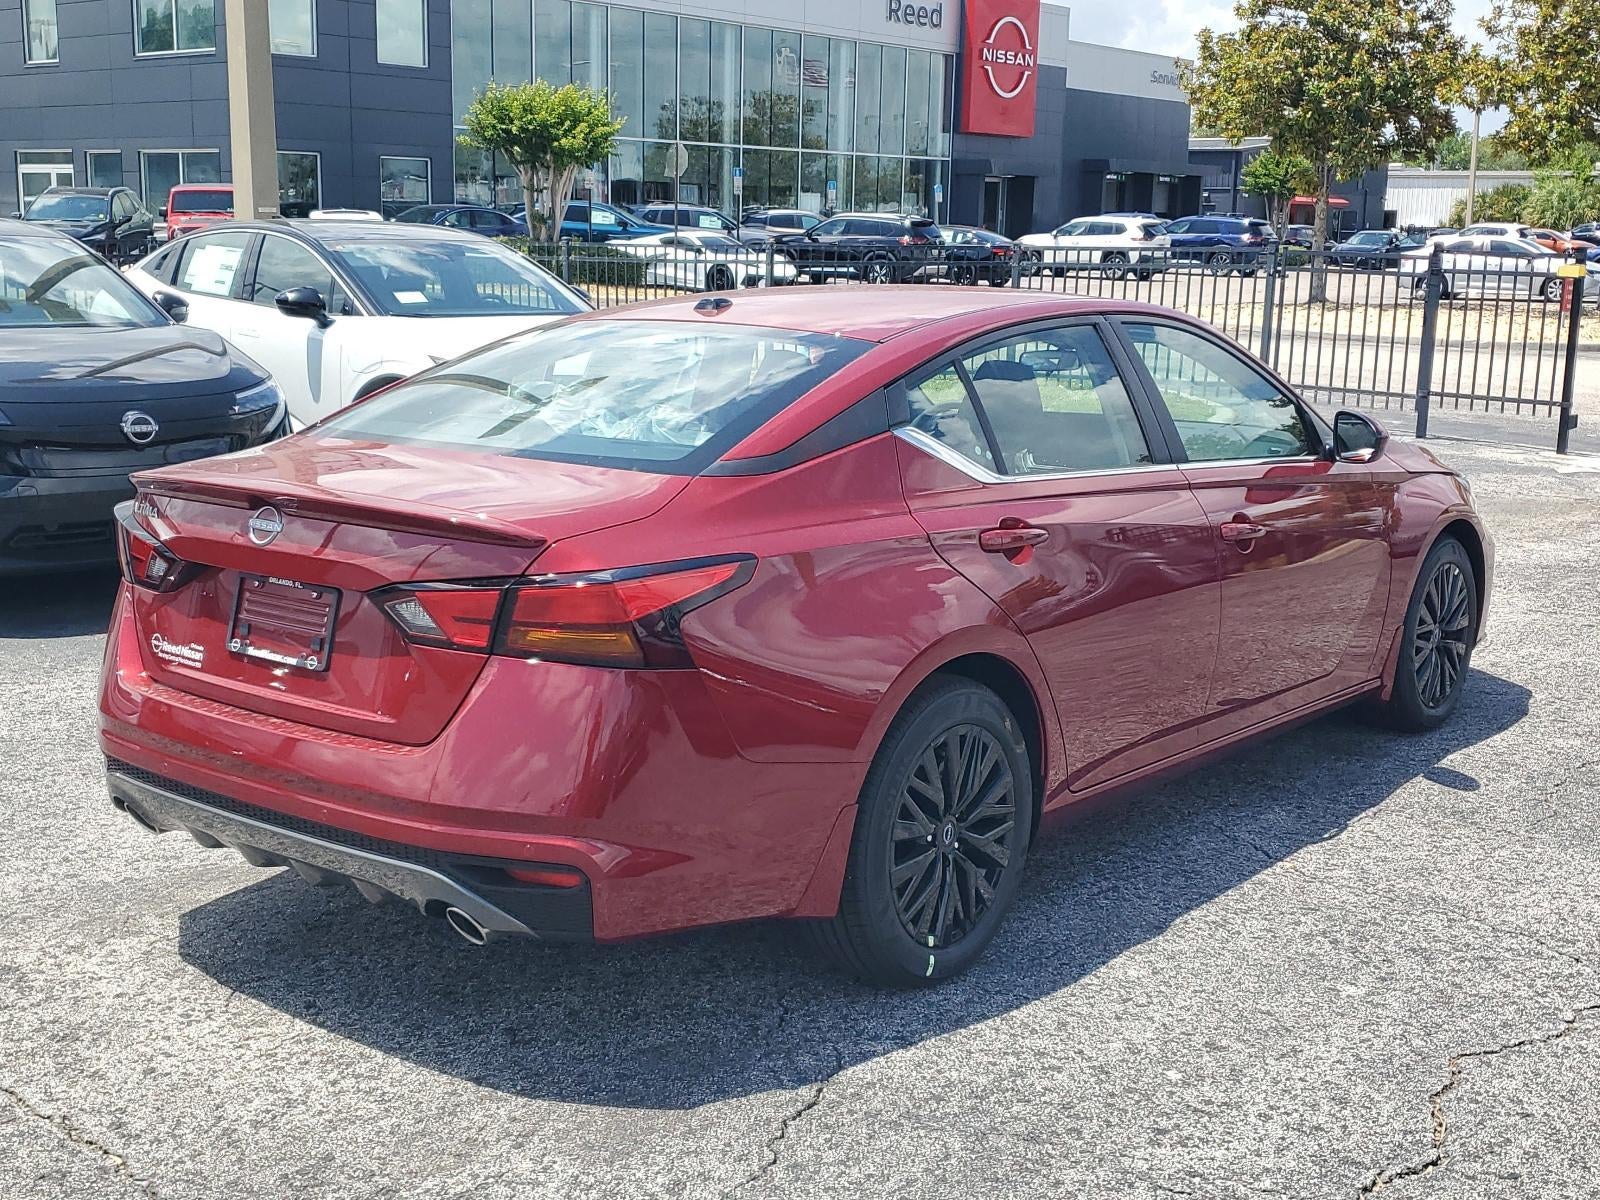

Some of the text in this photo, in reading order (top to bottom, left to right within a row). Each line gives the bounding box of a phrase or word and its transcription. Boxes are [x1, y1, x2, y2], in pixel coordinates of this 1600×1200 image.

[887, 0, 943, 29] Reed
[982, 47, 1034, 67] NISSAN
[123, 424, 159, 433] NISSAN
[162, 641, 182, 655] Reed
[181, 645, 203, 661] Nissan
